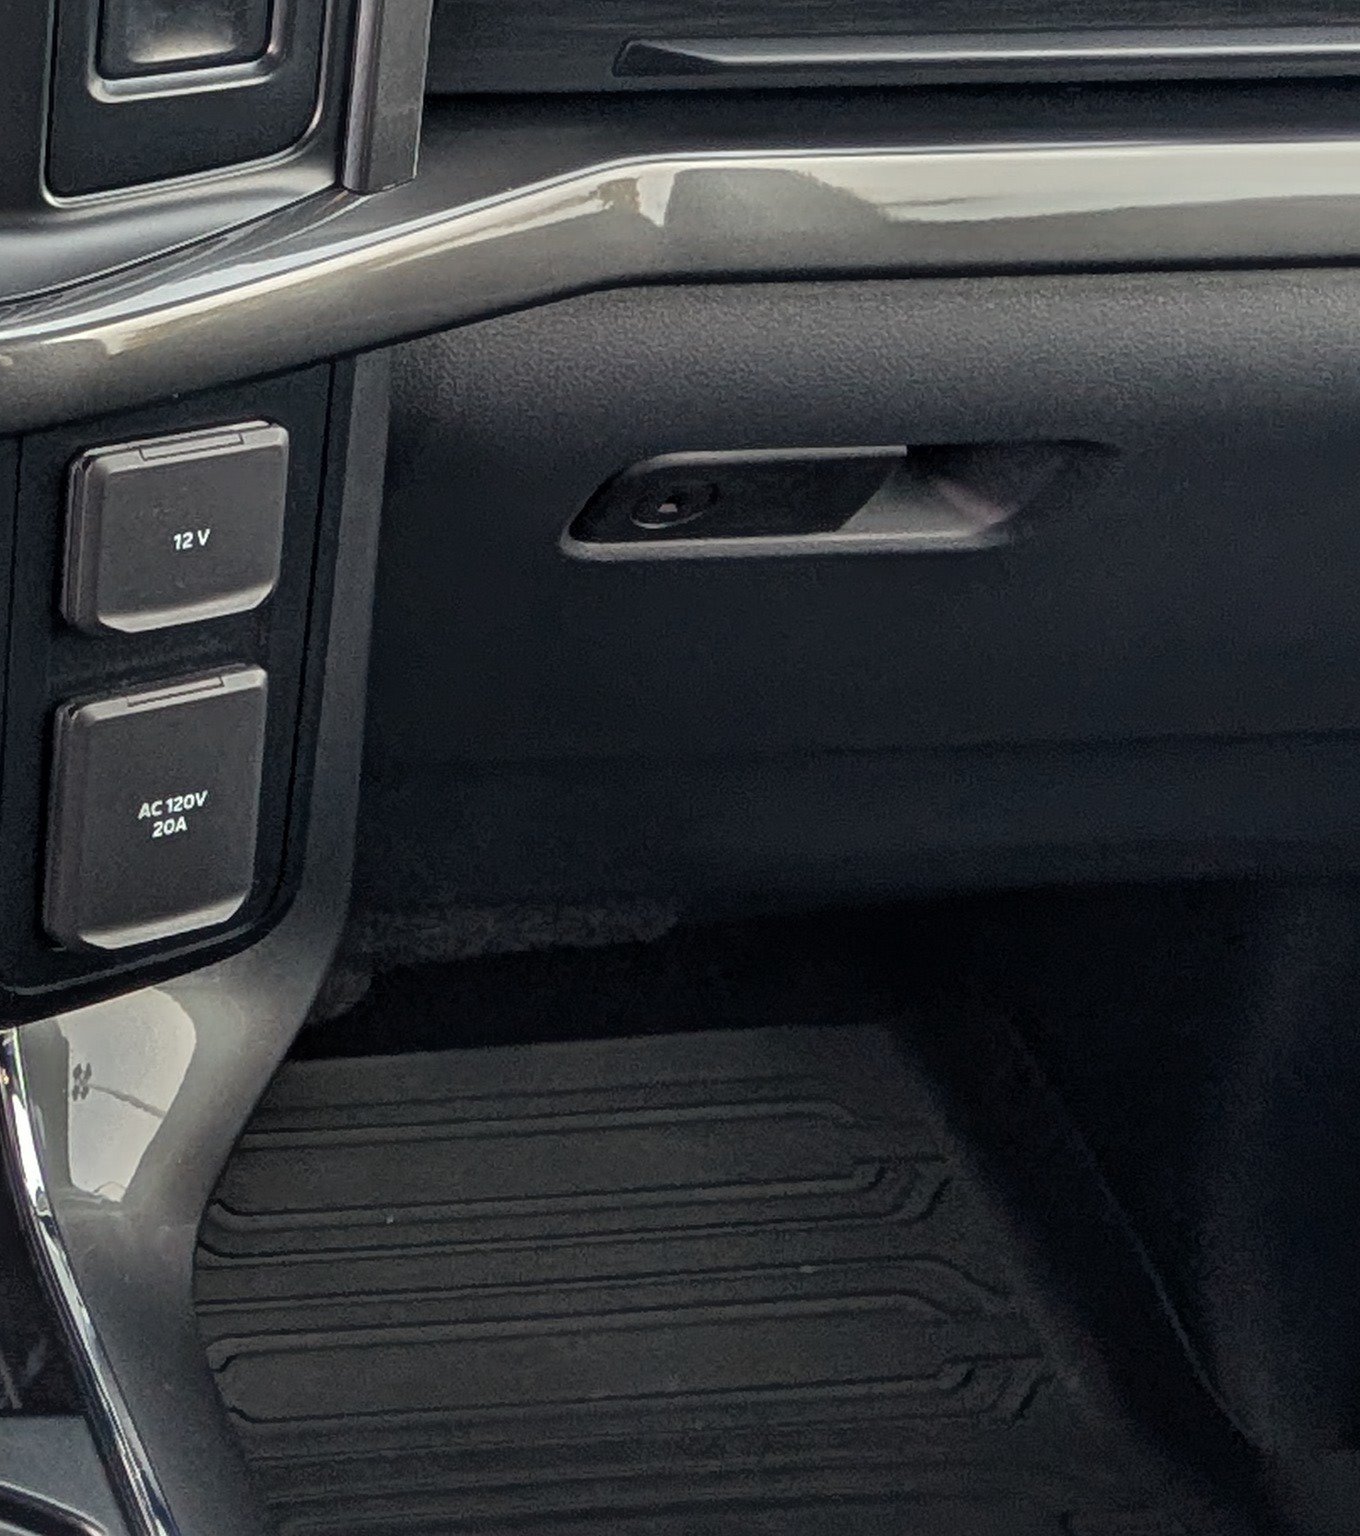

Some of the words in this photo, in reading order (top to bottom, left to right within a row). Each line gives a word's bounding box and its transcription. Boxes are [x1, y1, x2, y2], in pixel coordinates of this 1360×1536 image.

[174, 533, 194, 551] 12
[196, 530, 211, 547] V
[138, 801, 164, 820] AC
[167, 792, 208, 816] 120V
[152, 817, 188, 838] 20A
